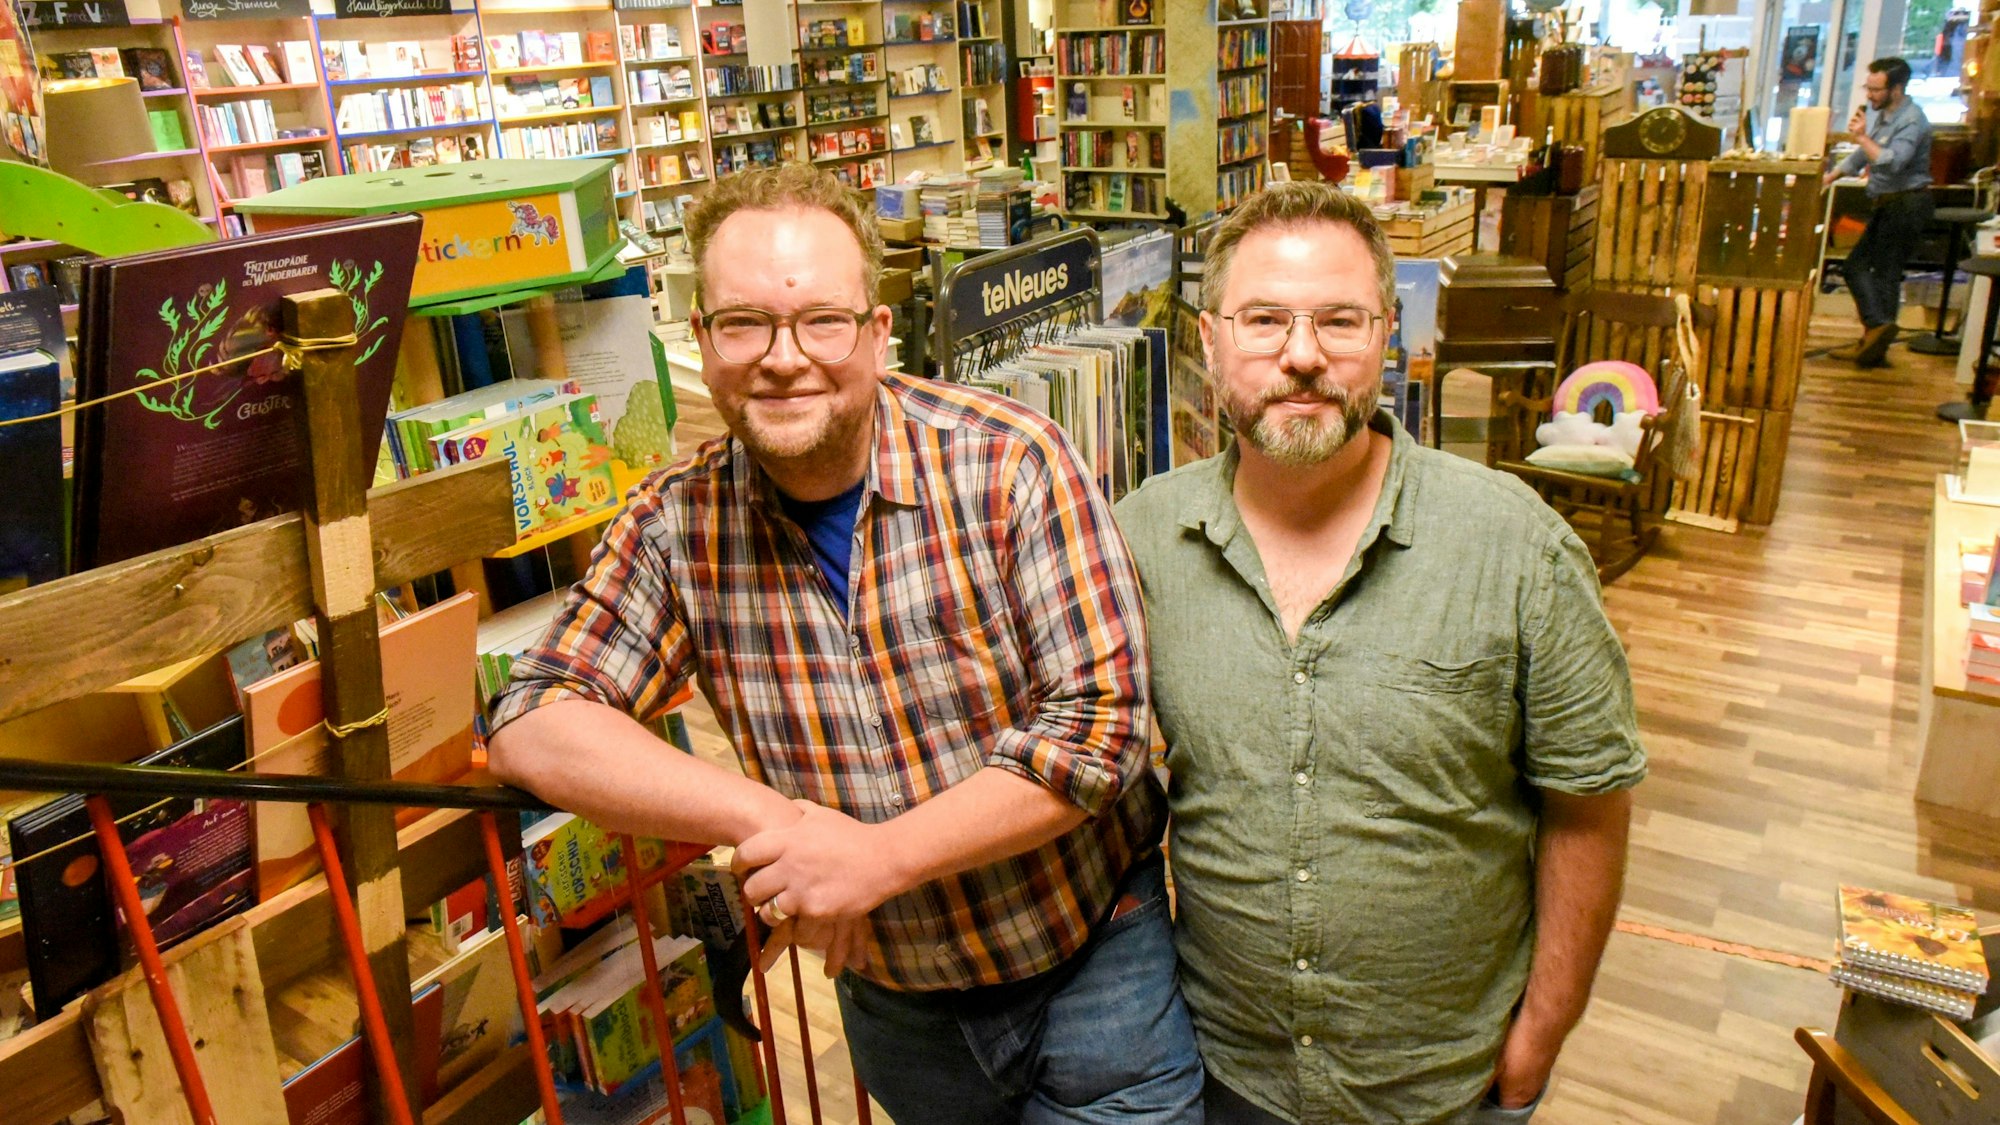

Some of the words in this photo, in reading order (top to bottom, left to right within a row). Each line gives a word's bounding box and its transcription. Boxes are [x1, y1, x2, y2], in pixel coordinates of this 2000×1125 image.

[416, 233, 522, 263] tickern
[251, 265, 319, 287] WUNDERBAREN
[981, 262, 1069, 317] teNeues
[237, 395, 291, 420] GEISTER
[566, 827, 586, 903] VORSCHUL-
